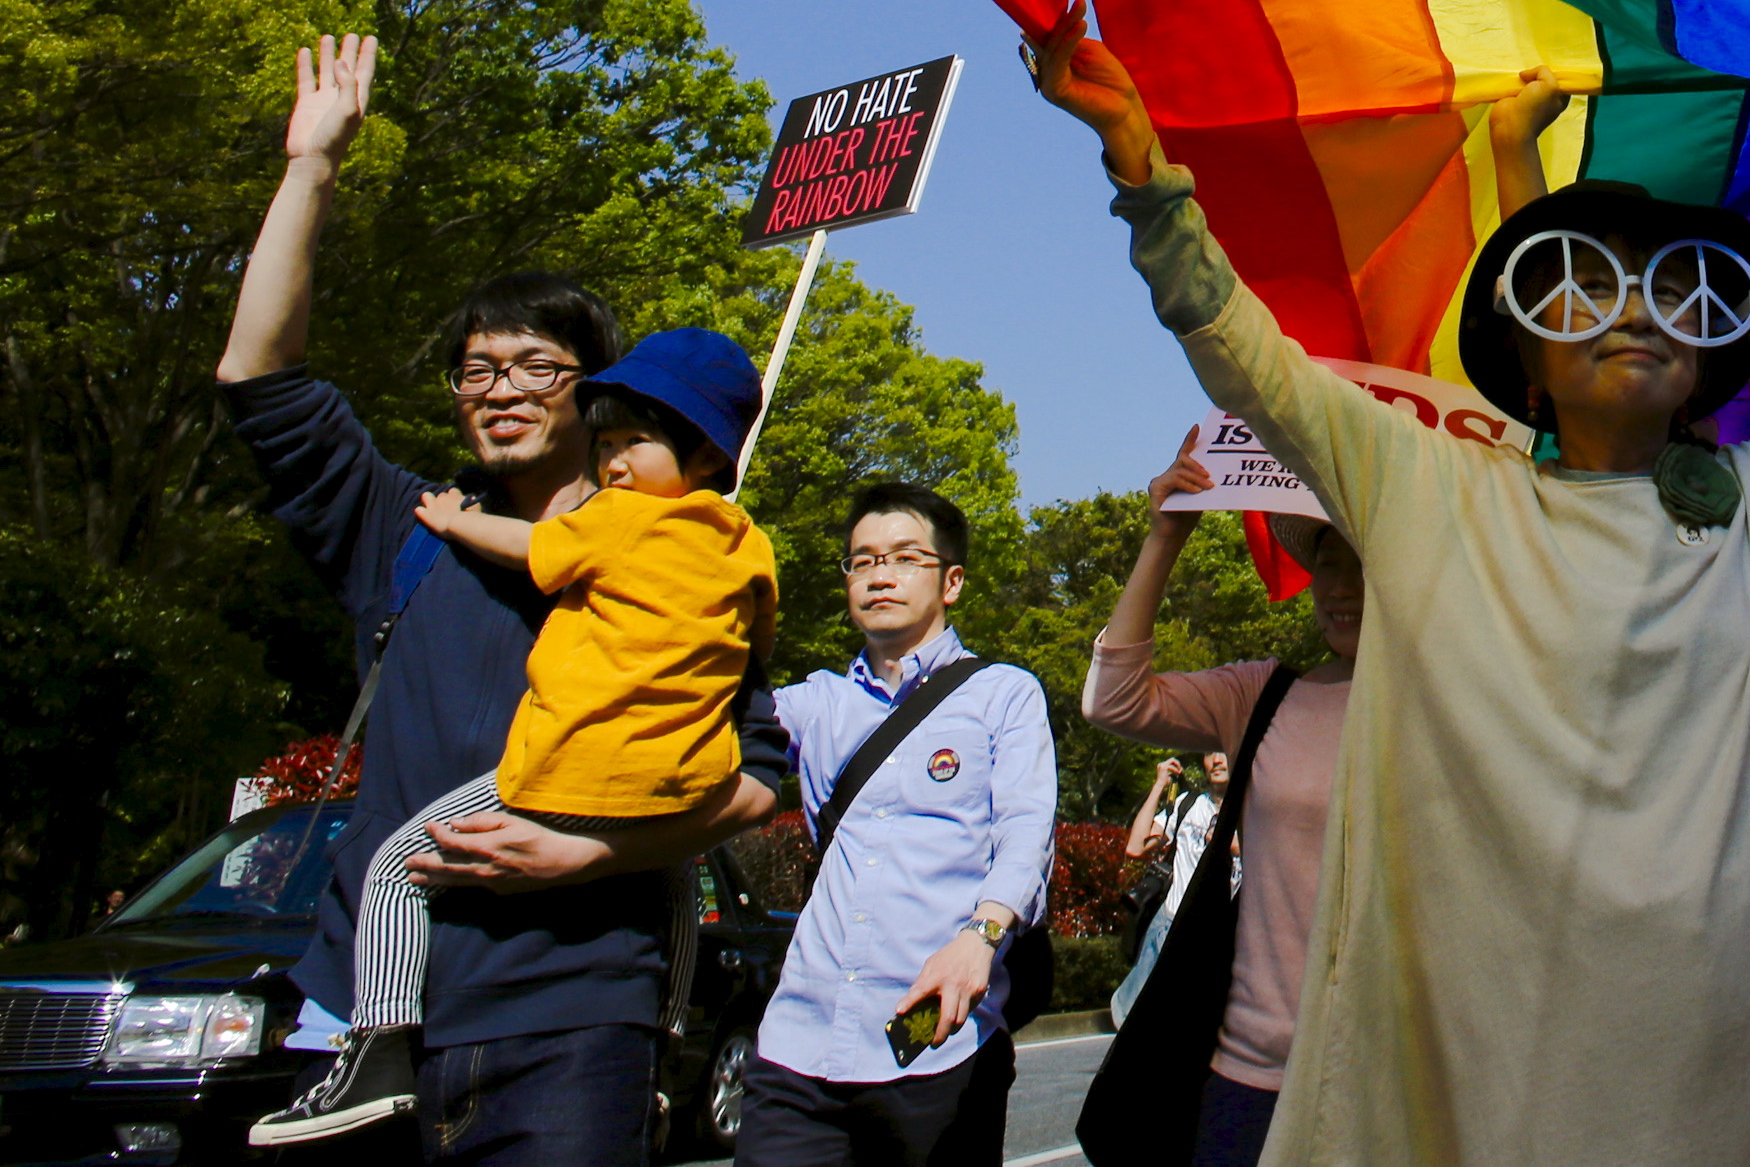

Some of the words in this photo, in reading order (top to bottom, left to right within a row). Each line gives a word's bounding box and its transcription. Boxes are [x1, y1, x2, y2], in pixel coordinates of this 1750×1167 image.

[804, 88, 849, 139] NO
[850, 68, 923, 127] HATE
[771, 127, 865, 188] UNDER
[868, 111, 924, 165] THE
[764, 162, 899, 235] RAINBOW
[1211, 424, 1253, 446] IS
[1220, 474, 1301, 490] LIVING
